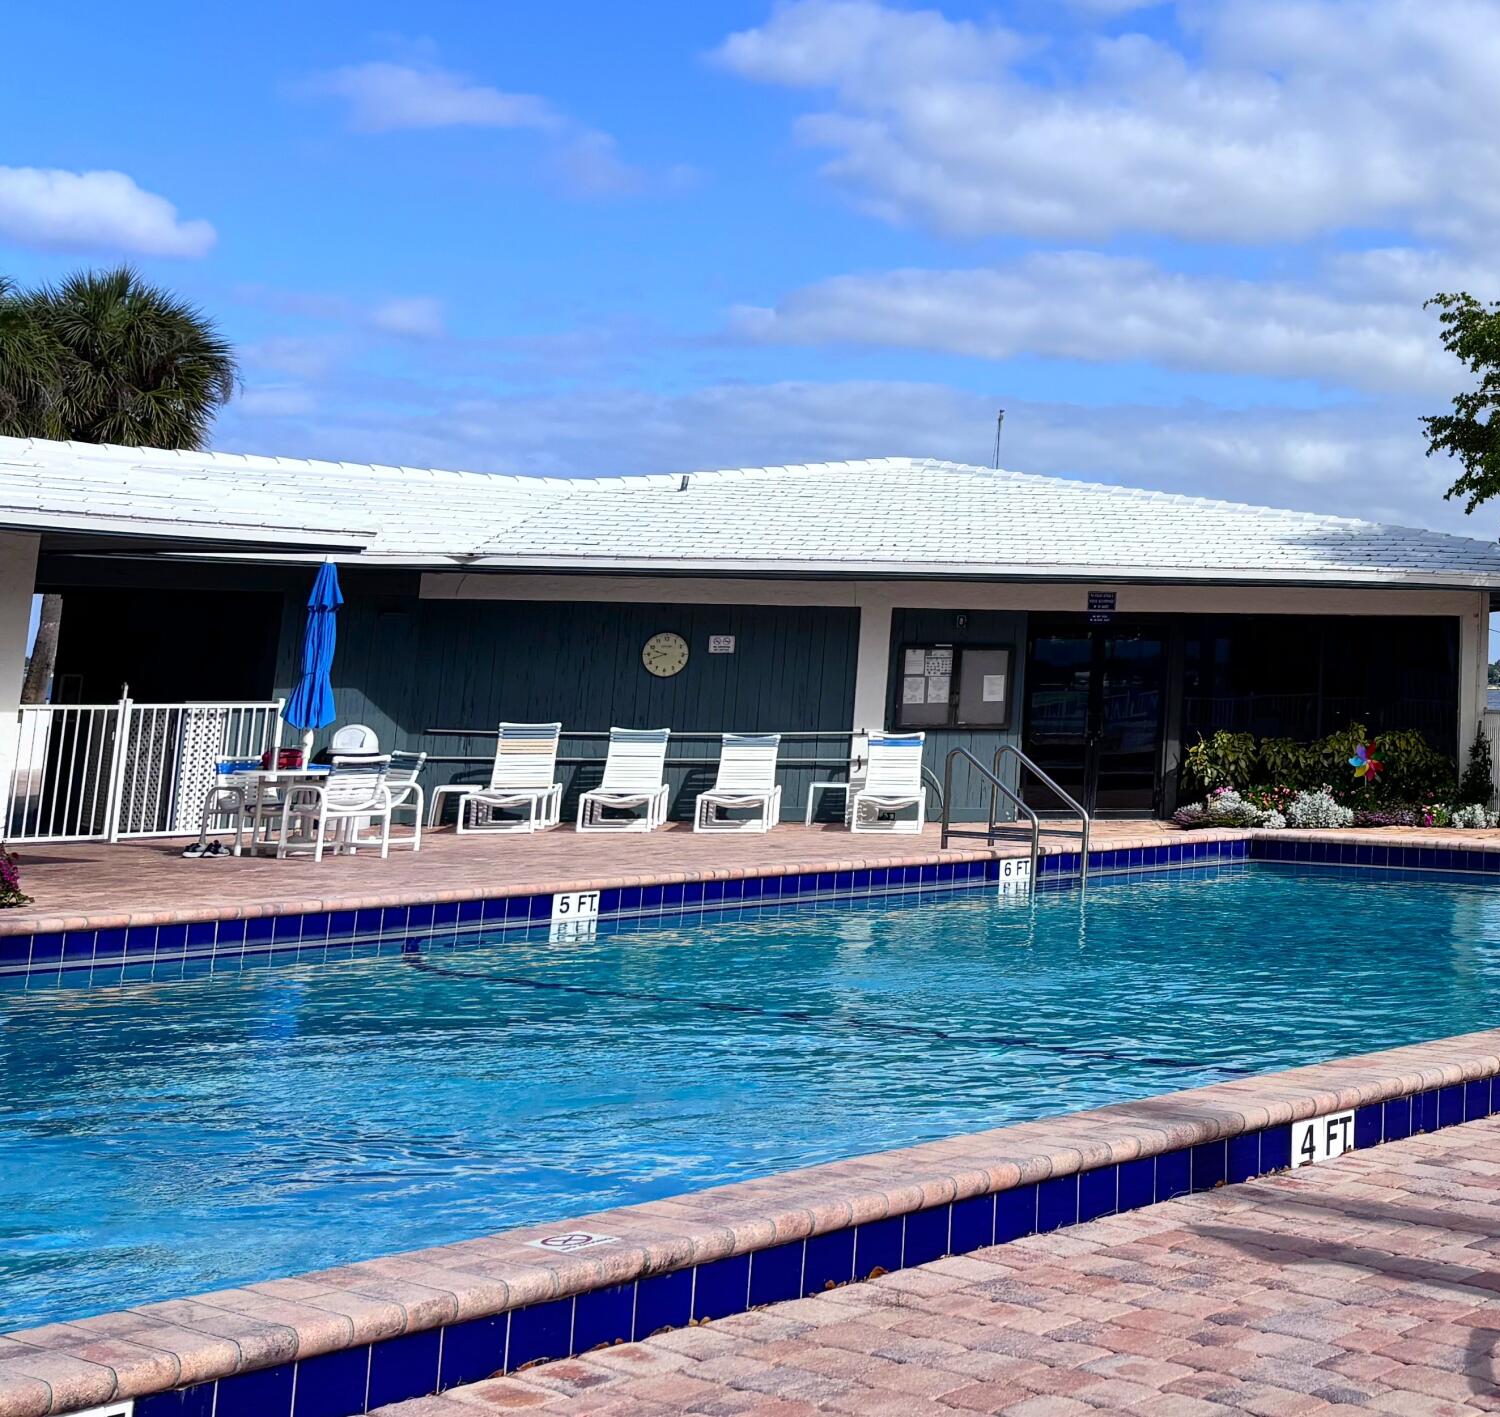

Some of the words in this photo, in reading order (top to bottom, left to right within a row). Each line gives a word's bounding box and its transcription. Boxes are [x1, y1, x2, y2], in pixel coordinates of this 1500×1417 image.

[1004, 862, 1011, 877] 6
[559, 895, 570, 914] 5
[577, 893, 597, 913] FT.
[1301, 1124, 1316, 1161] 4
